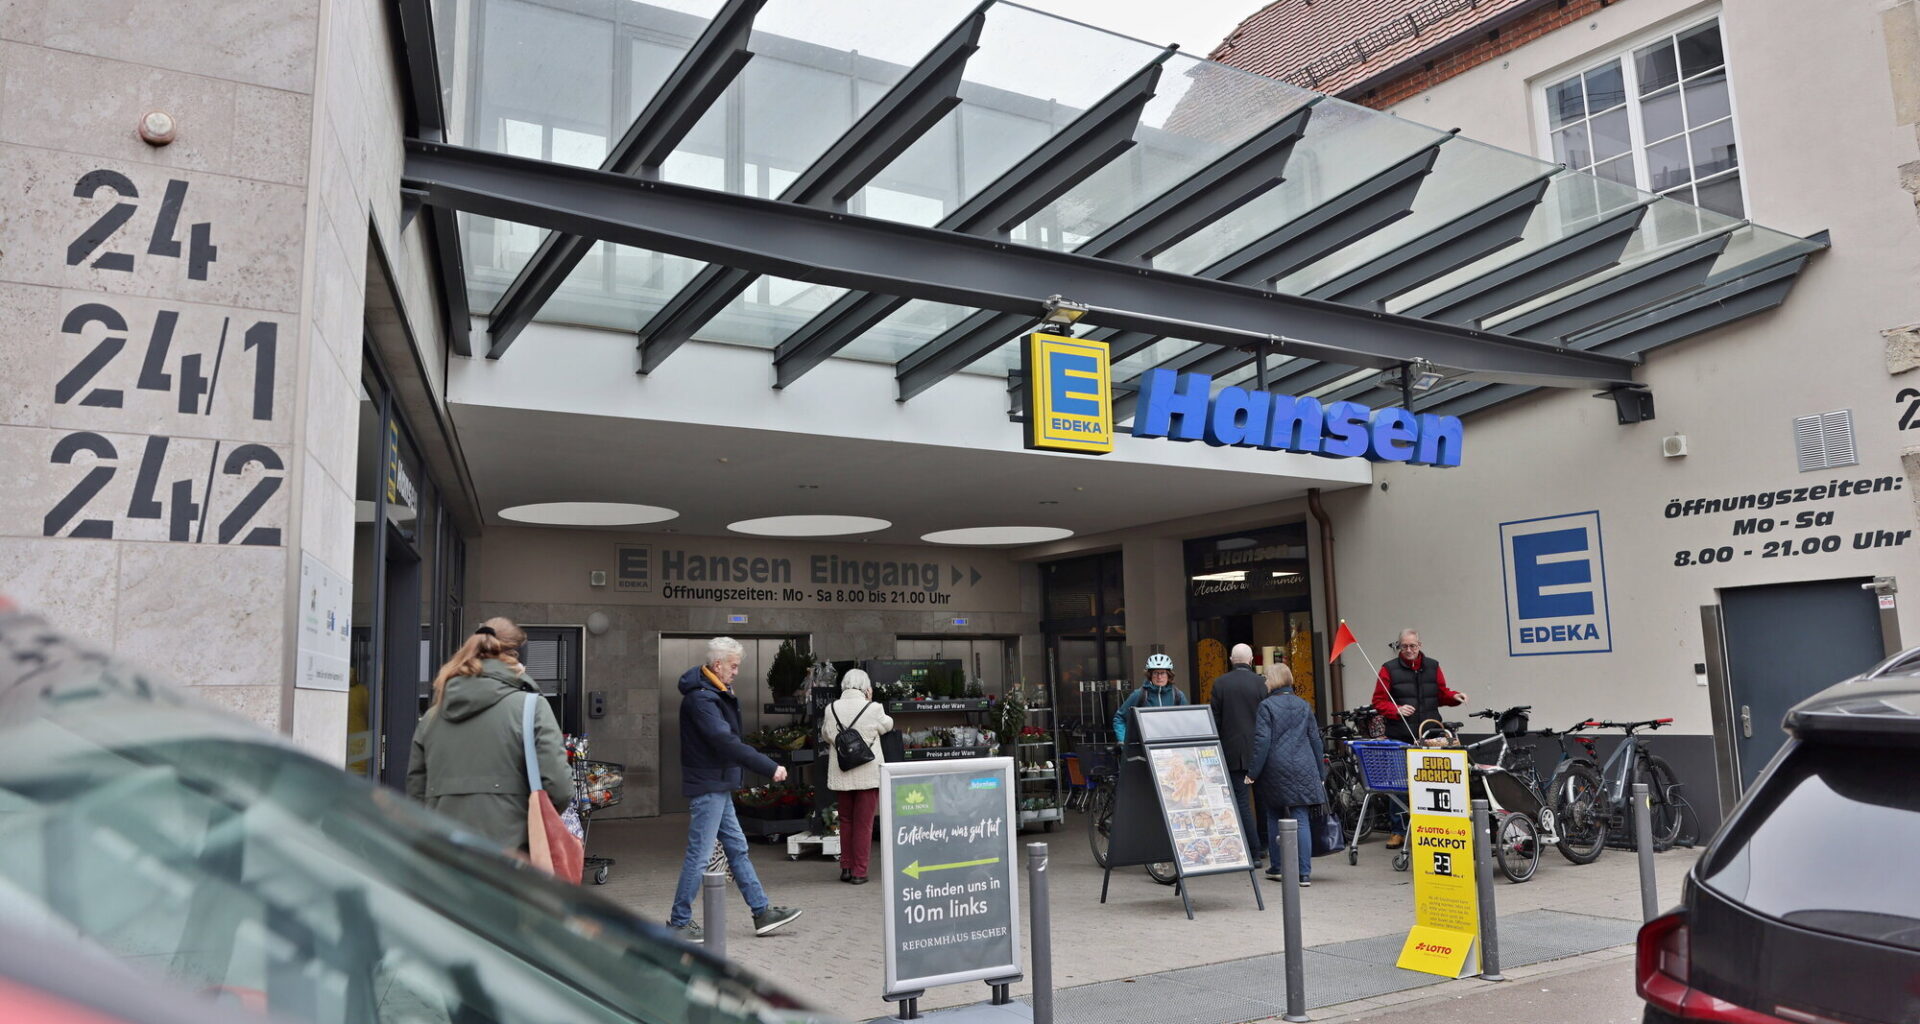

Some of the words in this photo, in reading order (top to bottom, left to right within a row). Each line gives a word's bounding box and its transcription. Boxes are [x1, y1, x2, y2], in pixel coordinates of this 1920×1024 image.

[66, 169, 218, 281] 24
[55, 302, 279, 421] 24/1
[1049, 351, 1100, 417] E
[1051, 416, 1103, 434] EDEKA
[1132, 368, 1465, 468] Hansen
[43, 431, 285, 545] 24/2
[1664, 475, 1903, 519] Öffnungszeiten:
[1732, 517, 1775, 536] Mo
[1795, 509, 1835, 529] Sa
[1218, 544, 1289, 567] Hansen
[1674, 546, 1734, 567] 8.00
[1762, 535, 1842, 559] 21.00
[1853, 530, 1911, 551] Uhr
[661, 549, 792, 583] Hansen
[810, 554, 940, 592] Eingang
[1512, 527, 1595, 620] E
[618, 580, 649, 589] EDEKA
[662, 584, 778, 603] Öffnungszeiten:
[782, 588, 804, 602] Mo
[816, 588, 833, 603] Sa
[836, 589, 865, 604] 8.00
[868, 588, 887, 604] bis
[890, 589, 925, 605] 21.00
[929, 590, 951, 606] Uhr
[1520, 622, 1601, 645] EDEKA
[1423, 757, 1451, 770] EURO
[1414, 769, 1461, 784] JACKPOT
[1438, 792, 1450, 809] 10
[897, 822, 949, 846] Entdecken,
[951, 824, 968, 838] was
[969, 818, 985, 844] gut
[986, 816, 1002, 838] tut
[1425, 826, 1444, 835] LOTTO
[1418, 836, 1467, 850] JACKPOT
[1434, 854, 1451, 874] 23
[902, 884, 922, 902] Sie
[926, 881, 964, 900] finden
[967, 880, 987, 894] uns
[989, 877, 1001, 890] in
[949, 897, 988, 920] links
[903, 932, 969, 951] REFORMHAUS
[970, 926, 1007, 943] ESCHER
[1426, 943, 1452, 955] LOTTO
